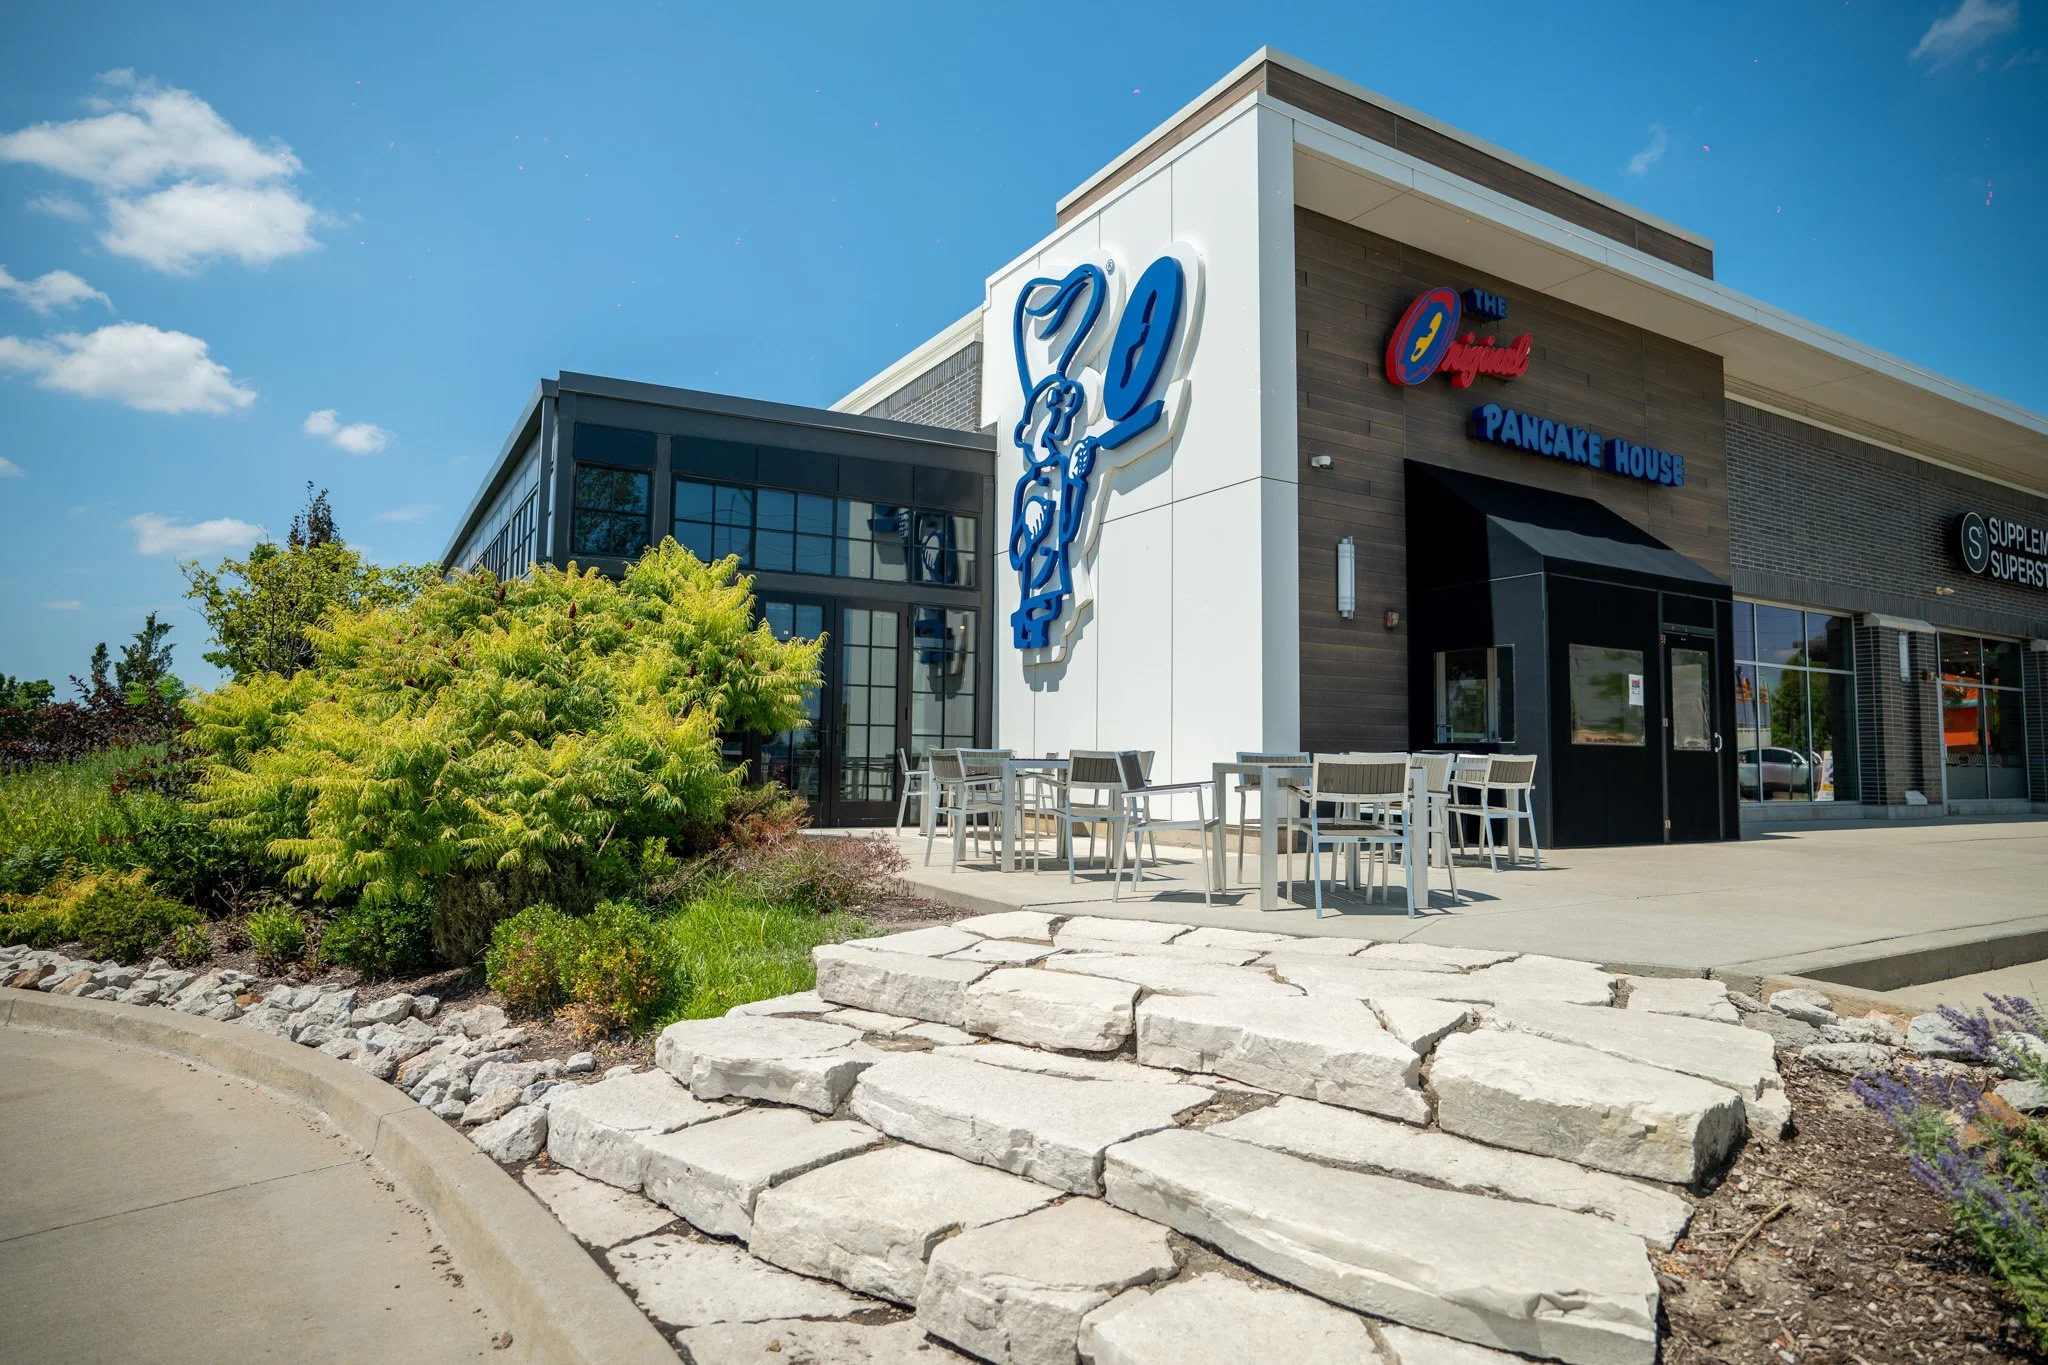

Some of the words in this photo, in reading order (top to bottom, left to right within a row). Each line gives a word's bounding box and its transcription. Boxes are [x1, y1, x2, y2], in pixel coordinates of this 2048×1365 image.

[1470, 287, 1508, 320] THE
[1480, 403, 1602, 468] PANCAKE
[1610, 437, 1685, 488] HOUSE
